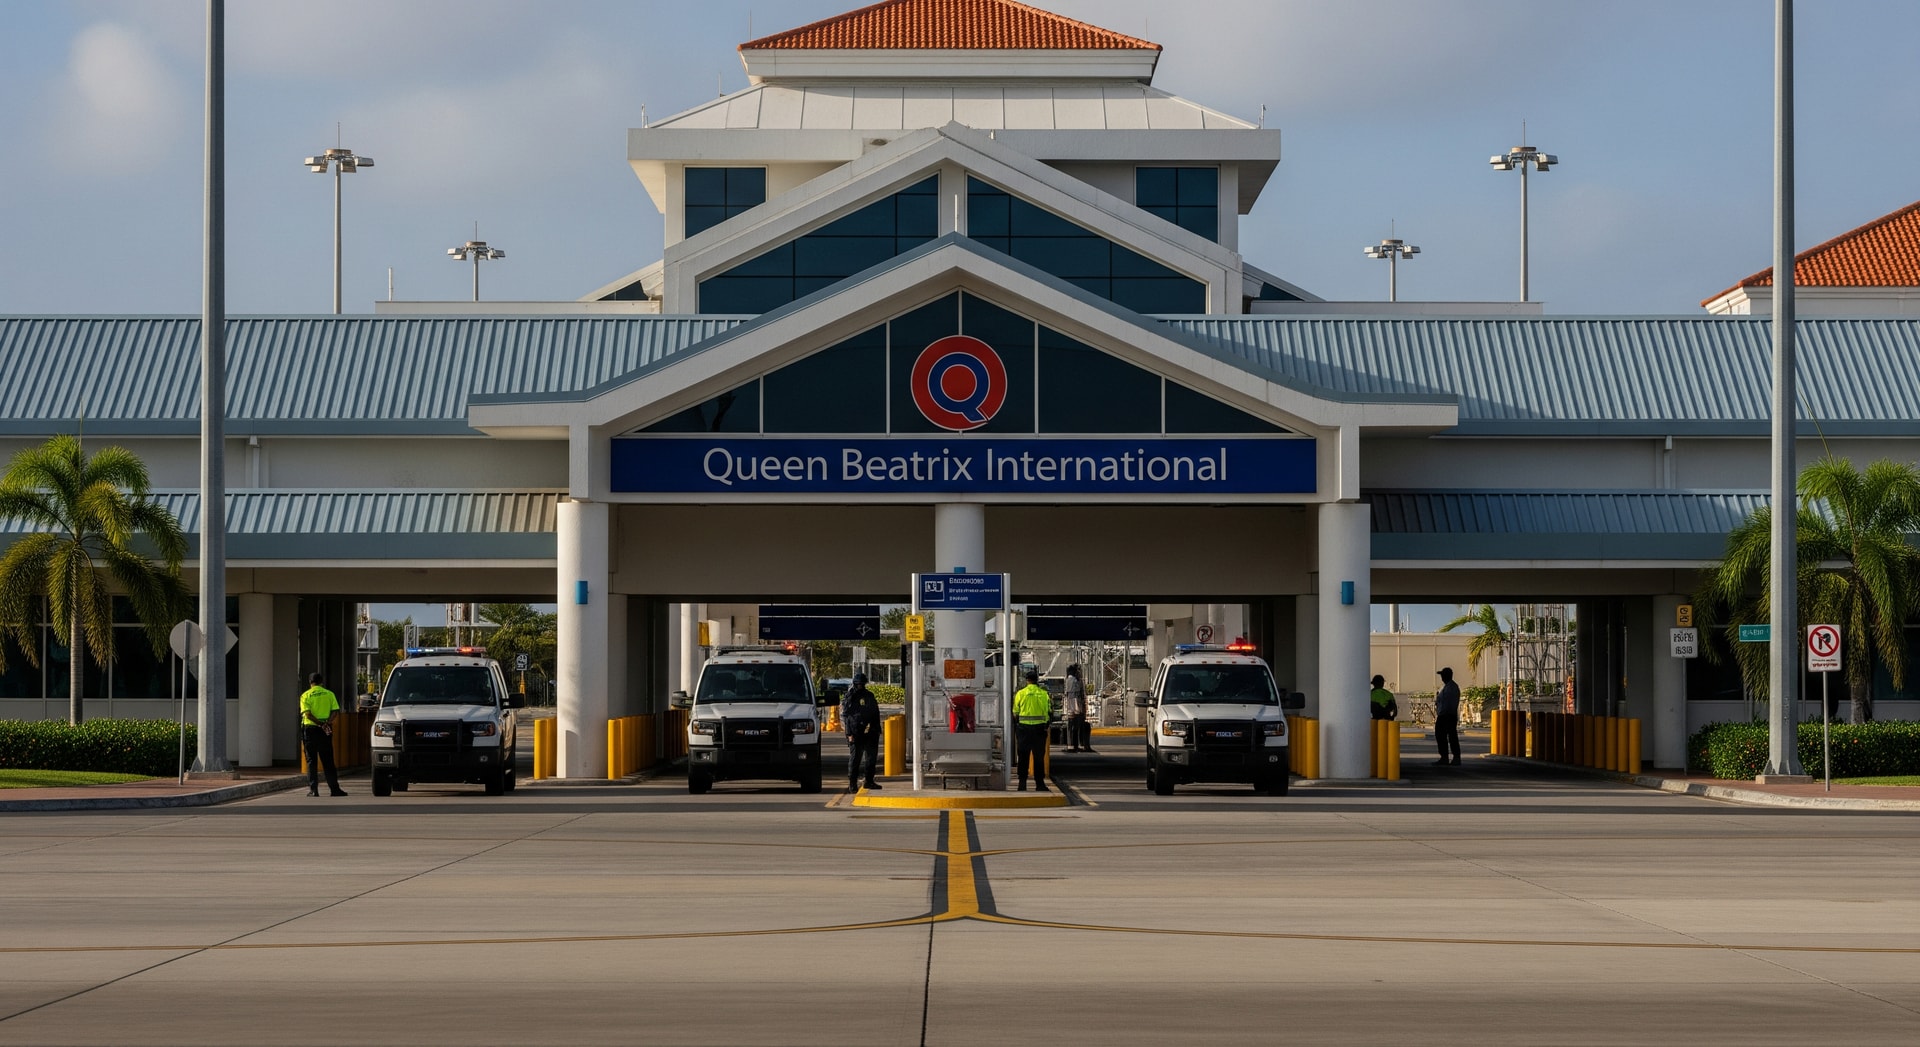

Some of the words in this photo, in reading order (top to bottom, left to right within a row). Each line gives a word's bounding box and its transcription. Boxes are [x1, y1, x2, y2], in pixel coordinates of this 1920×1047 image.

[927, 351, 990, 423] Q
[703, 448, 828, 485] Queen
[842, 448, 973, 481] Beatrix
[987, 448, 1227, 481] International
